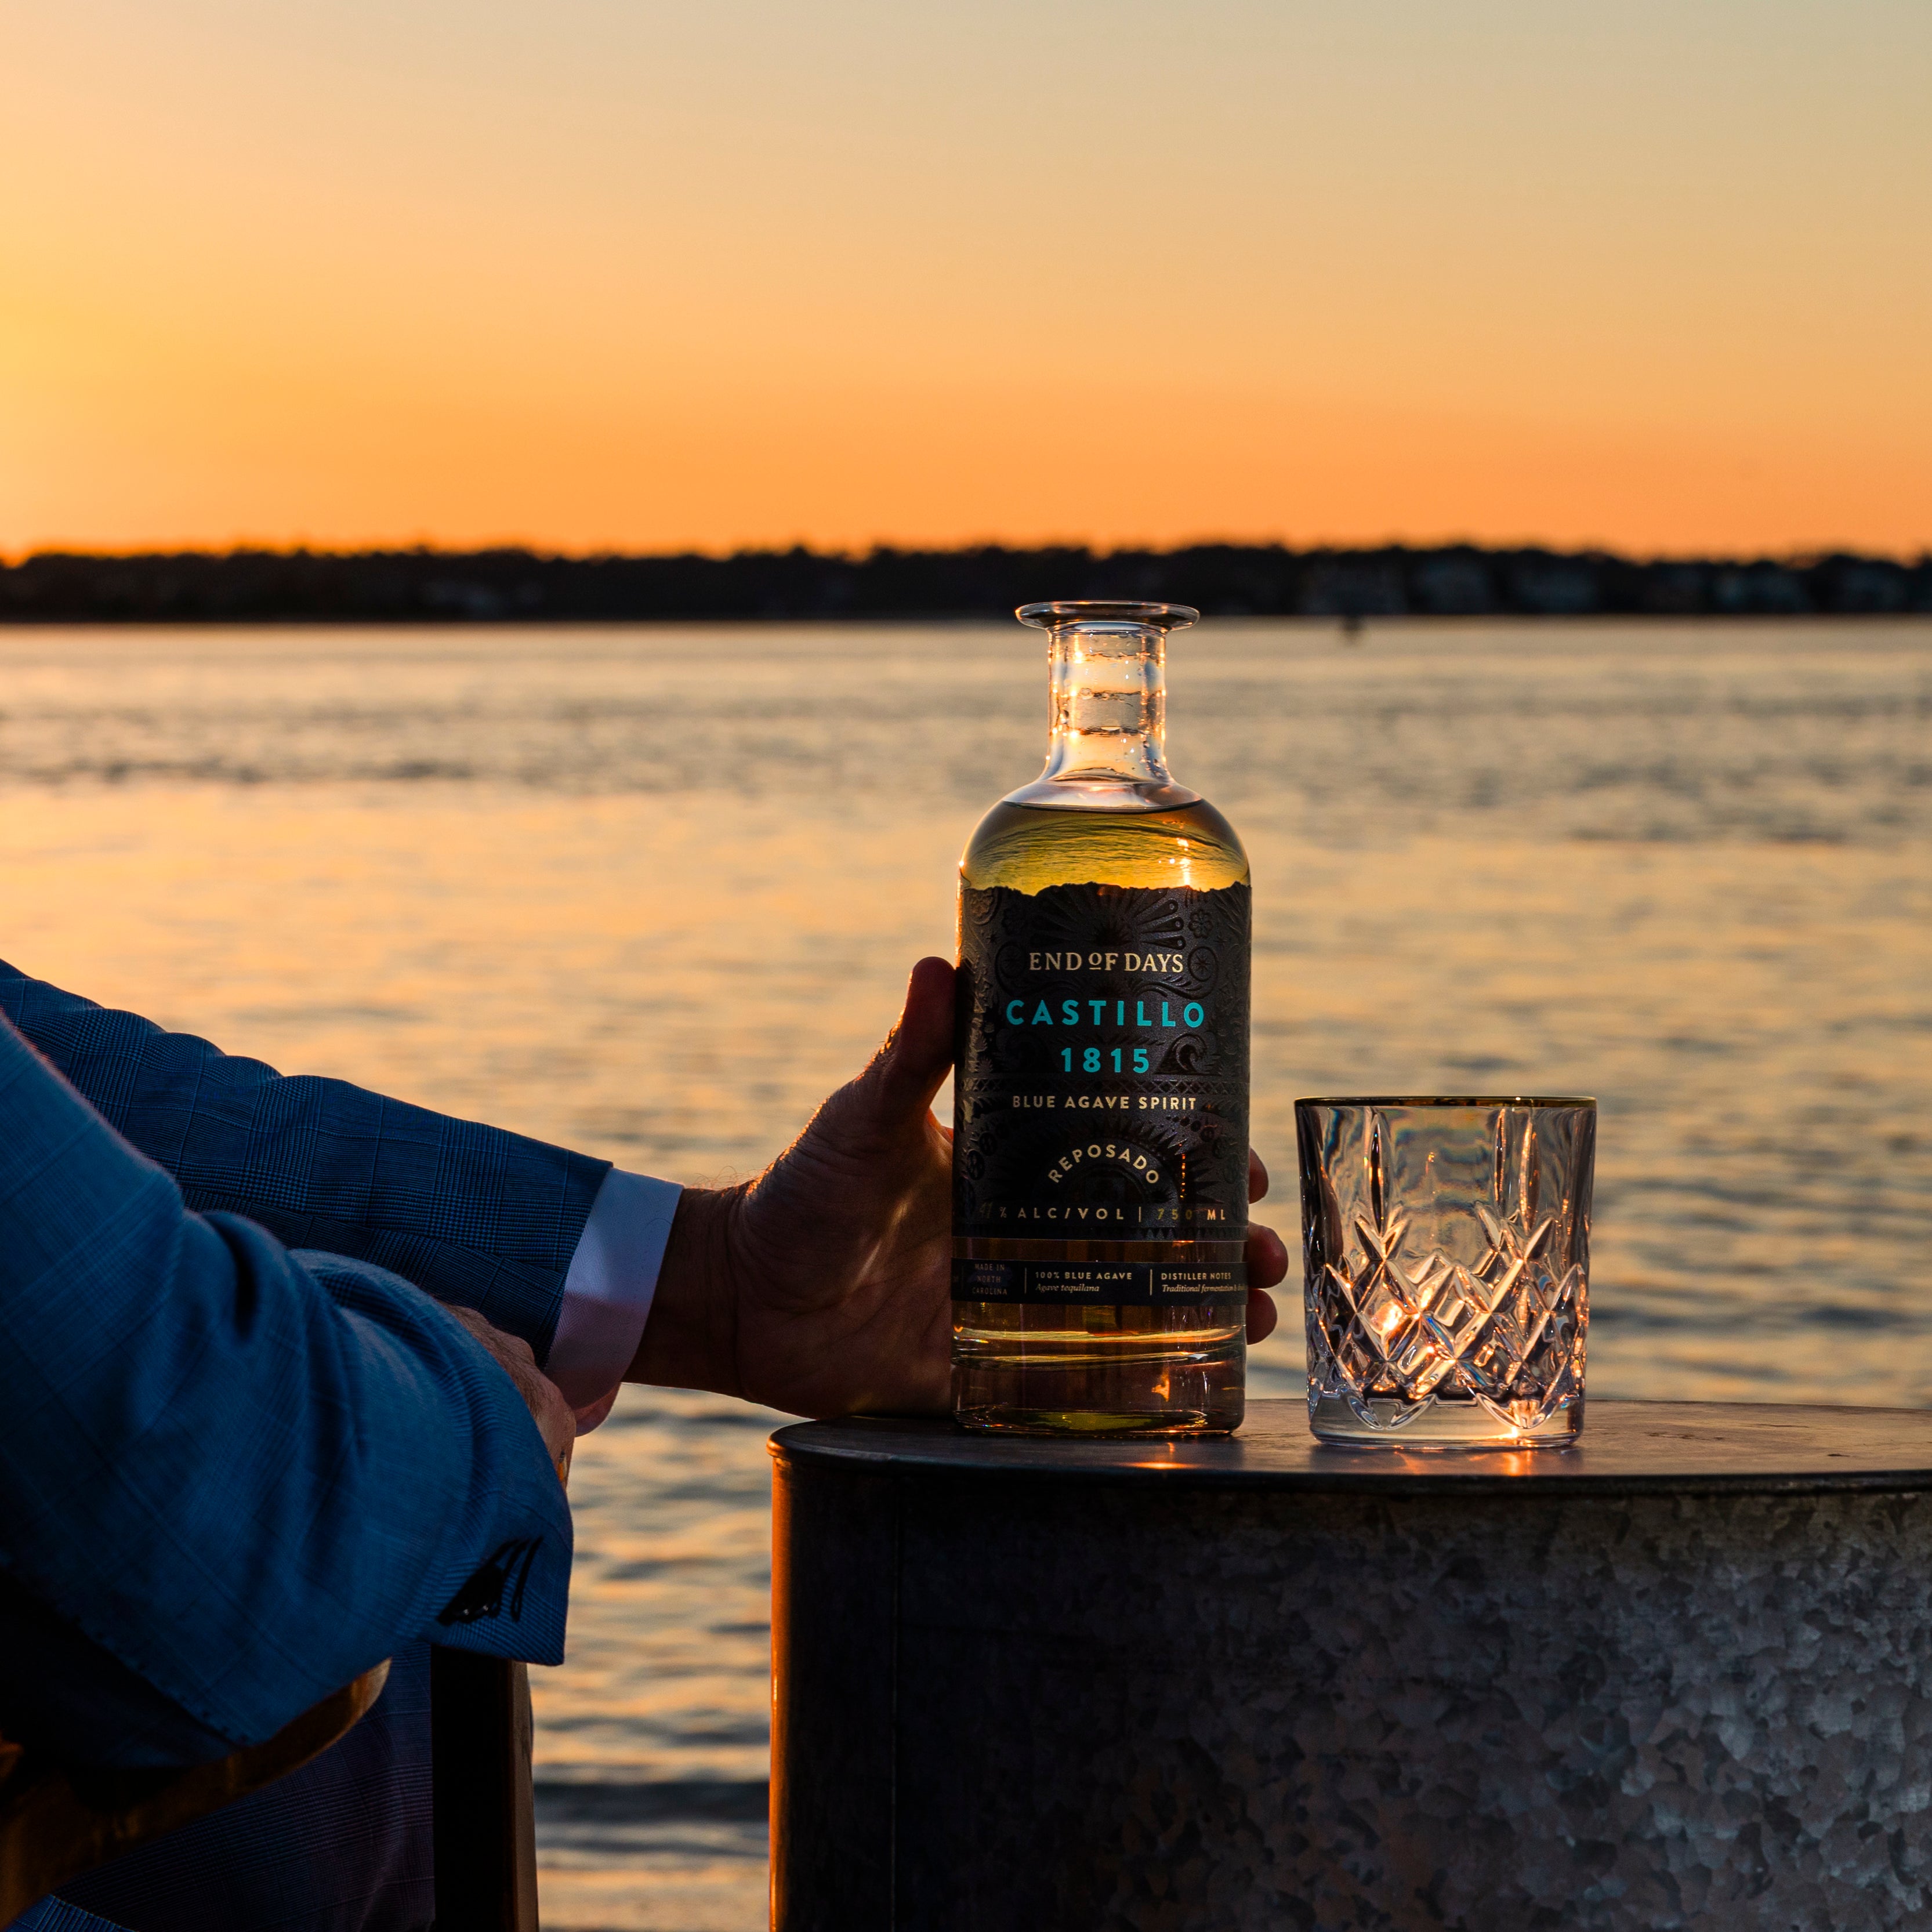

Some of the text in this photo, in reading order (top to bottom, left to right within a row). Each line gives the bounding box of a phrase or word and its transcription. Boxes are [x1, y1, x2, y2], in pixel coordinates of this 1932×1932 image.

[1030, 952, 1082, 970] END
[1125, 953, 1184, 973] DAYS
[1006, 999, 1204, 1028] CASTILLO
[1061, 1047, 1150, 1074] 1815
[1013, 1096, 1197, 1110] BLUE AGAVE SPIRIT
[1048, 1144, 1159, 1184] REPOSADO
[1017, 1207, 1124, 1220] ALC/VOL
[1156, 1208, 1226, 1221] 750 ML
[974, 1263, 1006, 1271] MADE IN
[972, 1287, 1007, 1295] CAROLINA
[1035, 1283, 1100, 1293] Agave tequilana
[1162, 1284, 1201, 1292] Traditional
